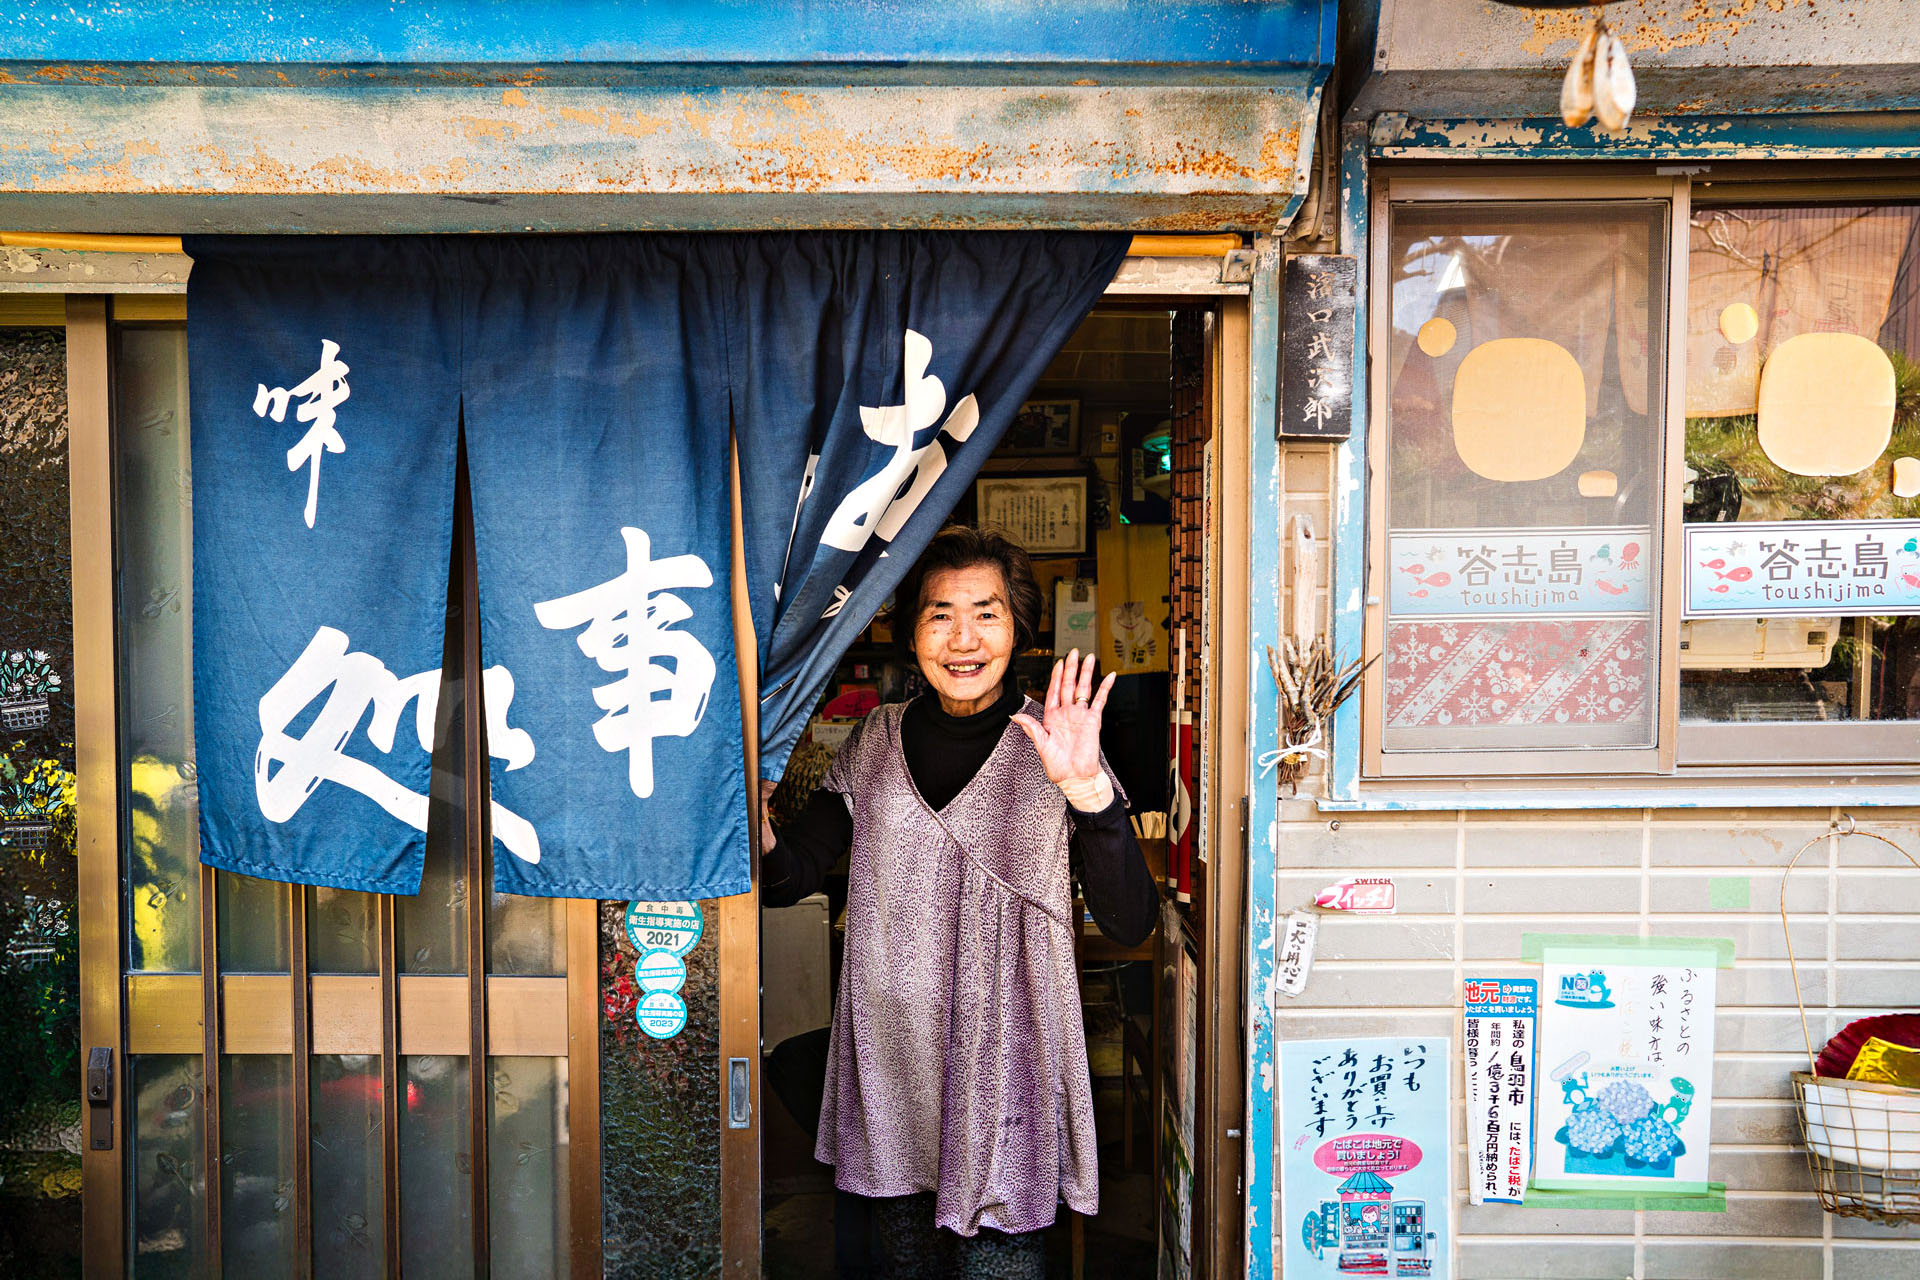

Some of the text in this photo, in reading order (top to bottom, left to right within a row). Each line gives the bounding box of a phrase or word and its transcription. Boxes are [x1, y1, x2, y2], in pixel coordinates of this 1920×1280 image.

[252, 338, 351, 529] 味
[1456, 540, 1584, 586] 答志島
[1759, 533, 1889, 582] 答志島
[1459, 587, 1580, 607] toushijima
[1761, 583, 1885, 602] toushijima
[534, 526, 716, 799] 事
[255, 625, 541, 864] 処
[646, 931, 680, 946] 2021
[1465, 982, 1500, 1003] 地元
[1676, 968, 1698, 1056] ふるさとの
[1337, 1048, 1368, 1130] ありがとう
[1364, 1054, 1396, 1129] お買い上げ
[1403, 1044, 1427, 1092] いつも
[1305, 1056, 1336, 1138] ございます
[1332, 1139, 1402, 1150] たばこは地元で
